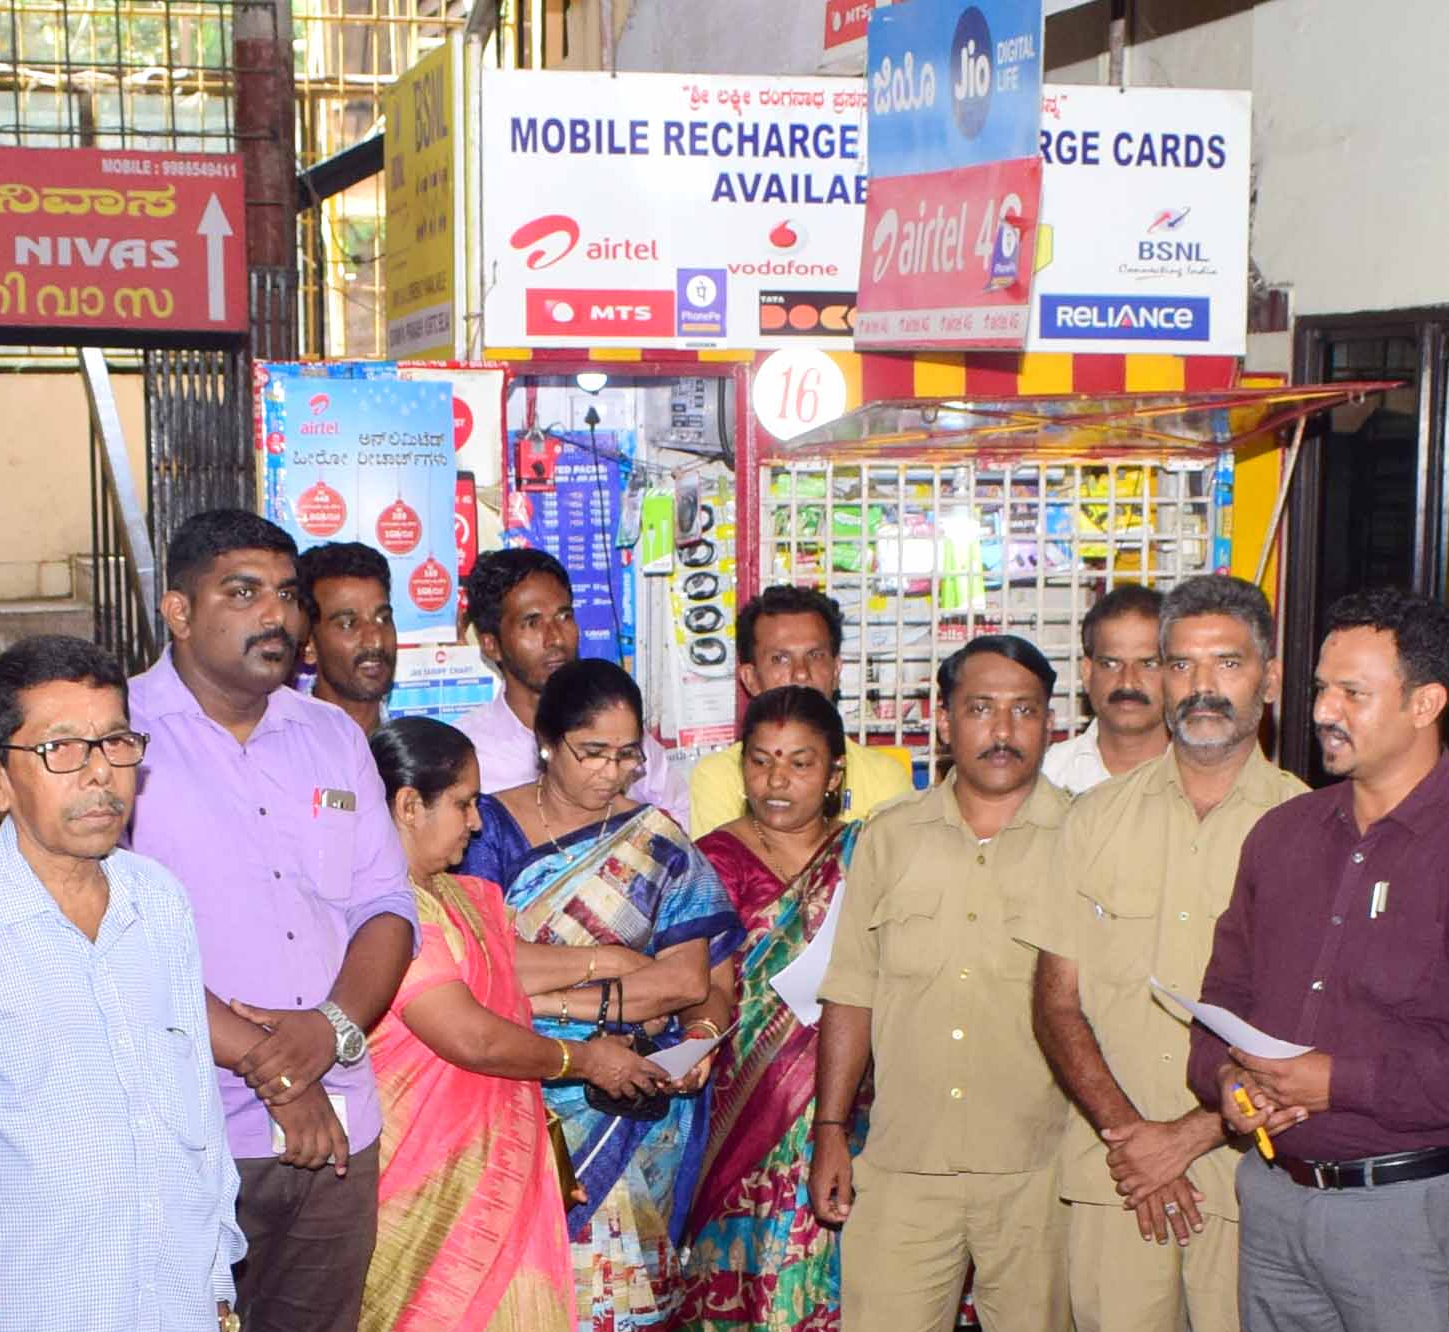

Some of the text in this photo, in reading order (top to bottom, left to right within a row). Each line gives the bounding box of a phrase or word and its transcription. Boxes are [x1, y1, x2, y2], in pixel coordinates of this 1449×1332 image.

[997, 34, 1035, 64] DIGITAL
[955, 39, 991, 100] Jio
[997, 66, 1019, 92] LIFE
[511, 117, 649, 154] MOBILE
[663, 120, 859, 159] RECHARGE
[1113, 132, 1226, 169] CARDS
[102, 158, 151, 174] MOBILE
[586, 238, 659, 260] airtel
[898, 200, 967, 275] airtel
[15, 237, 179, 270] NIVAS
[1138, 241, 1210, 262] BSNL
[728, 260, 839, 277] vodafone
[590, 305, 652, 321] MTS
[681, 311, 721, 322] PhonePe
[780, 367, 820, 423] 16
[301, 422, 340, 436] airtel
